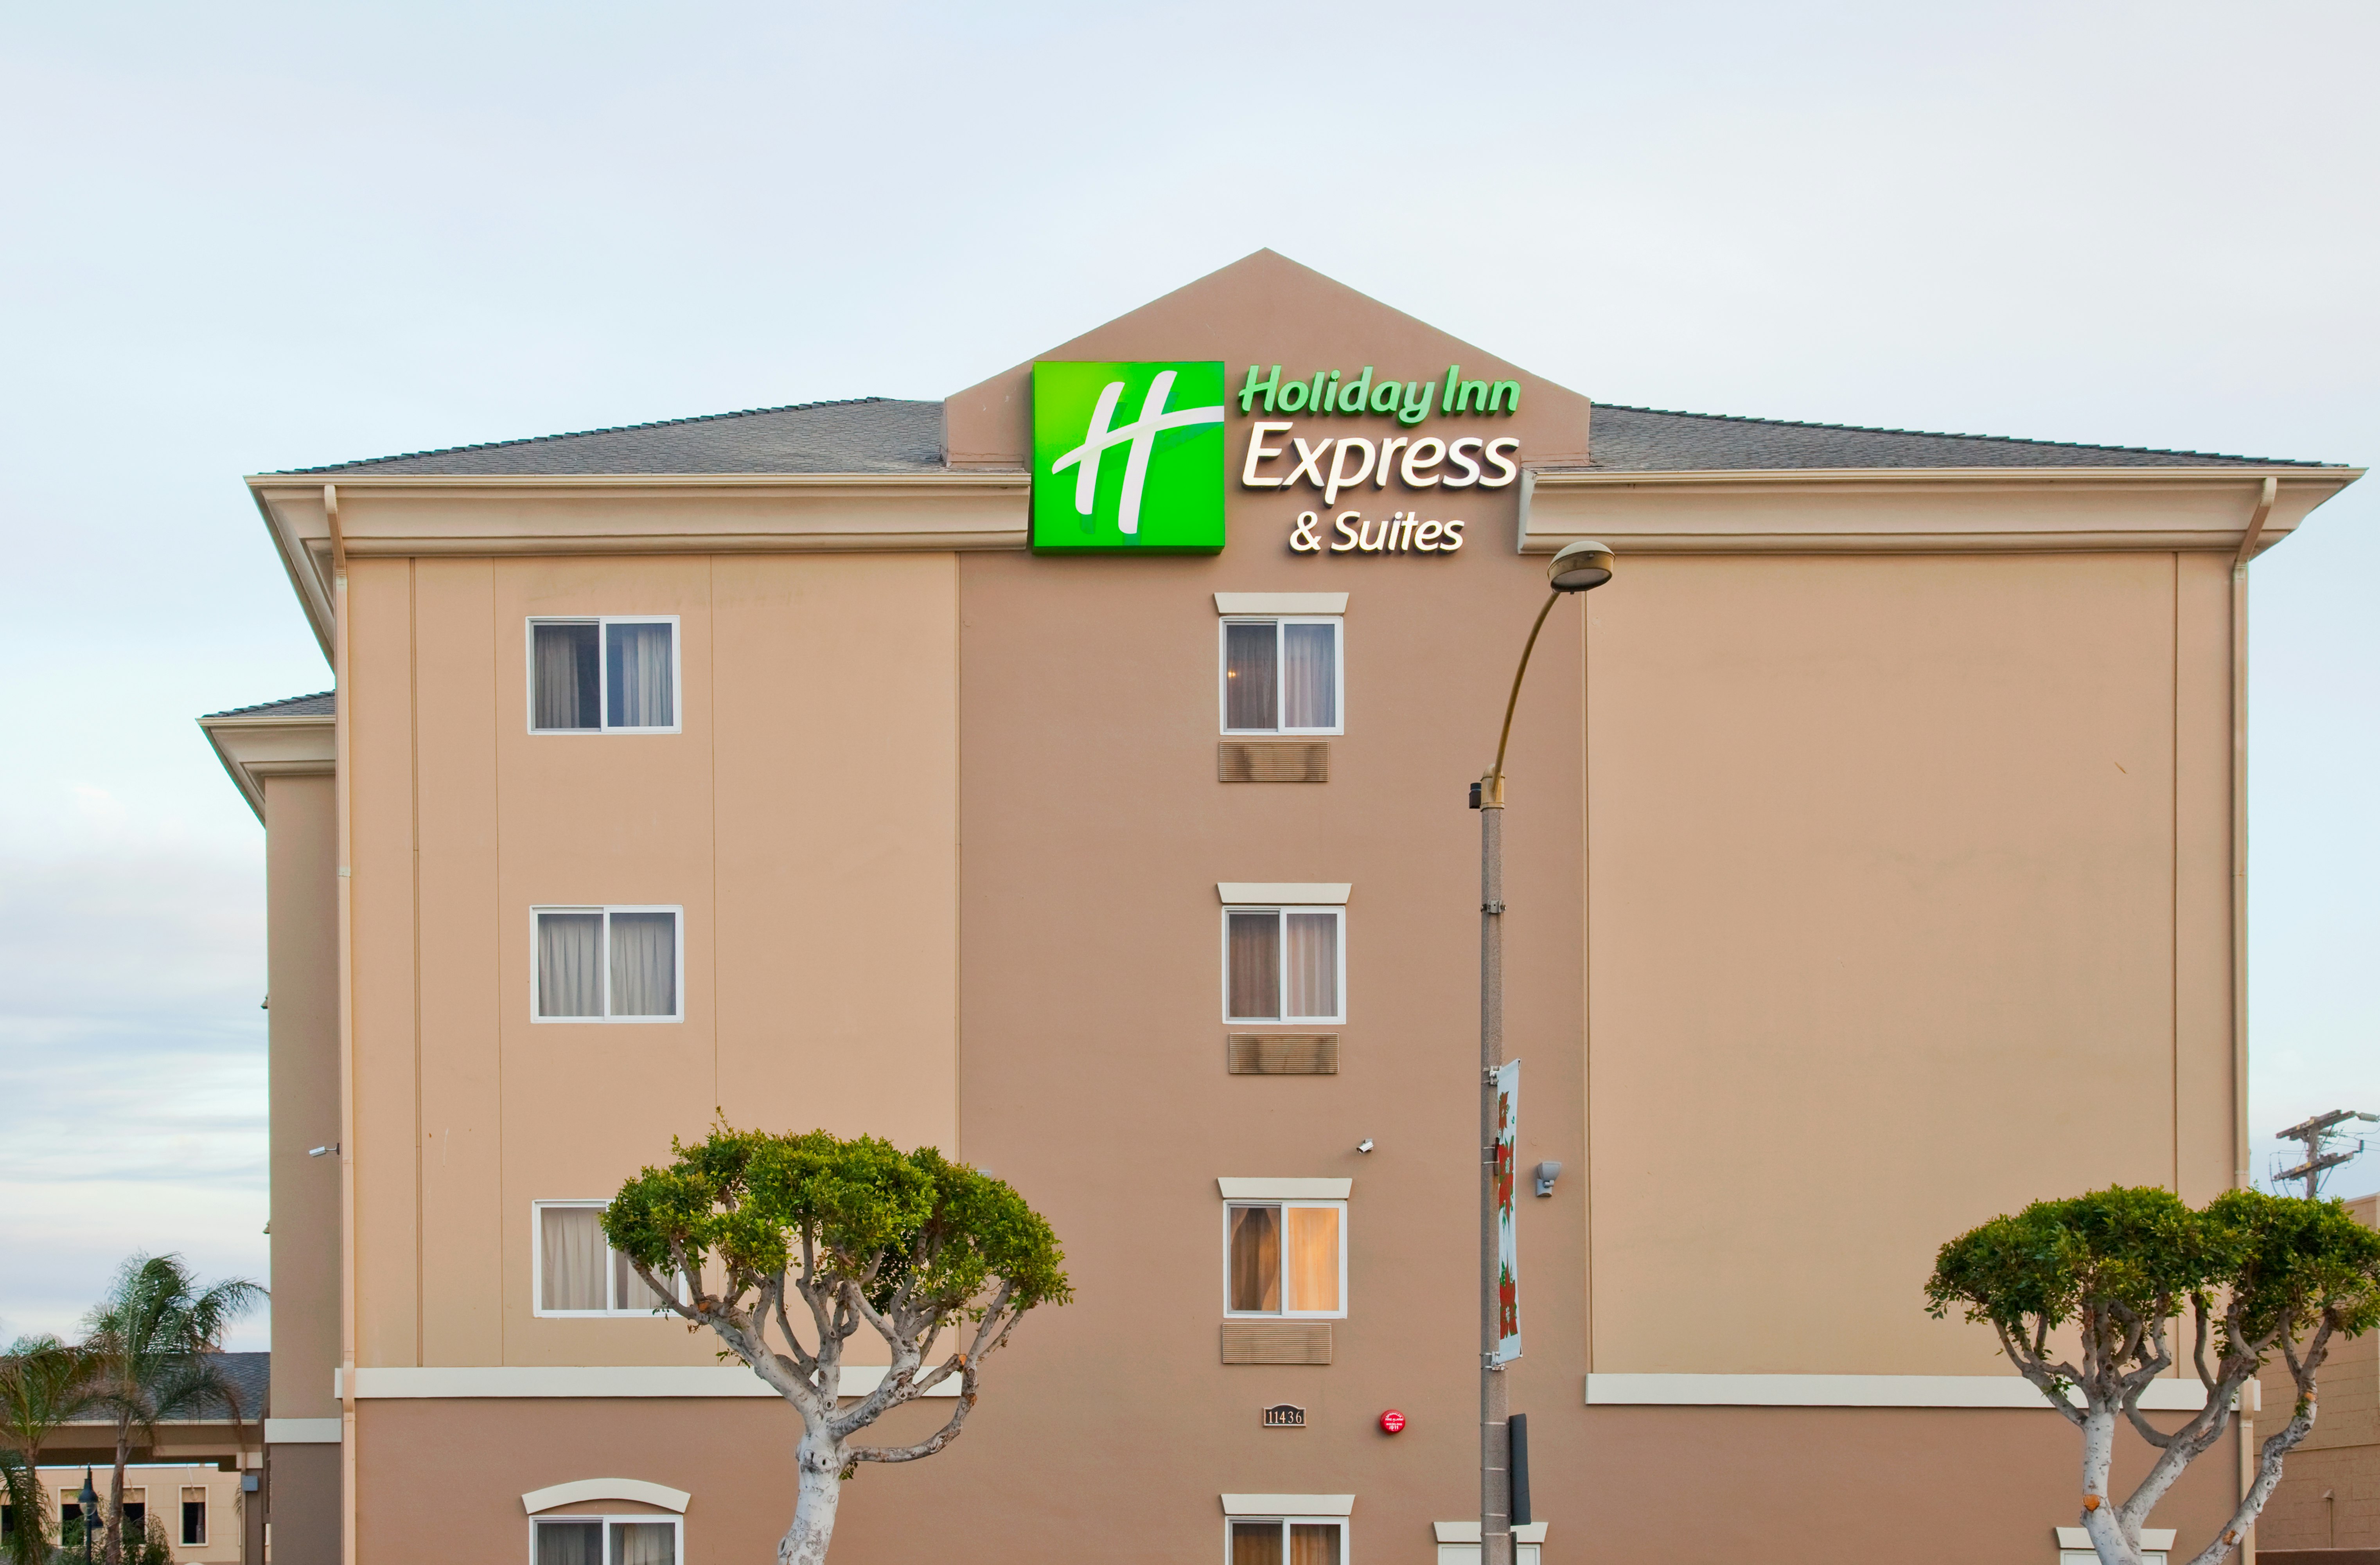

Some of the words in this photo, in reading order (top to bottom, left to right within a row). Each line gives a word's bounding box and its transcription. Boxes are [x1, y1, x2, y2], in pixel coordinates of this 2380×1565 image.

[1238, 364, 1436, 424] Holiday
[1441, 364, 1521, 412] Inn
[1241, 421, 1520, 506] Express
[1289, 510, 1322, 551] &
[1330, 510, 1465, 551] Suites
[1268, 1411, 1302, 1423] 11436
